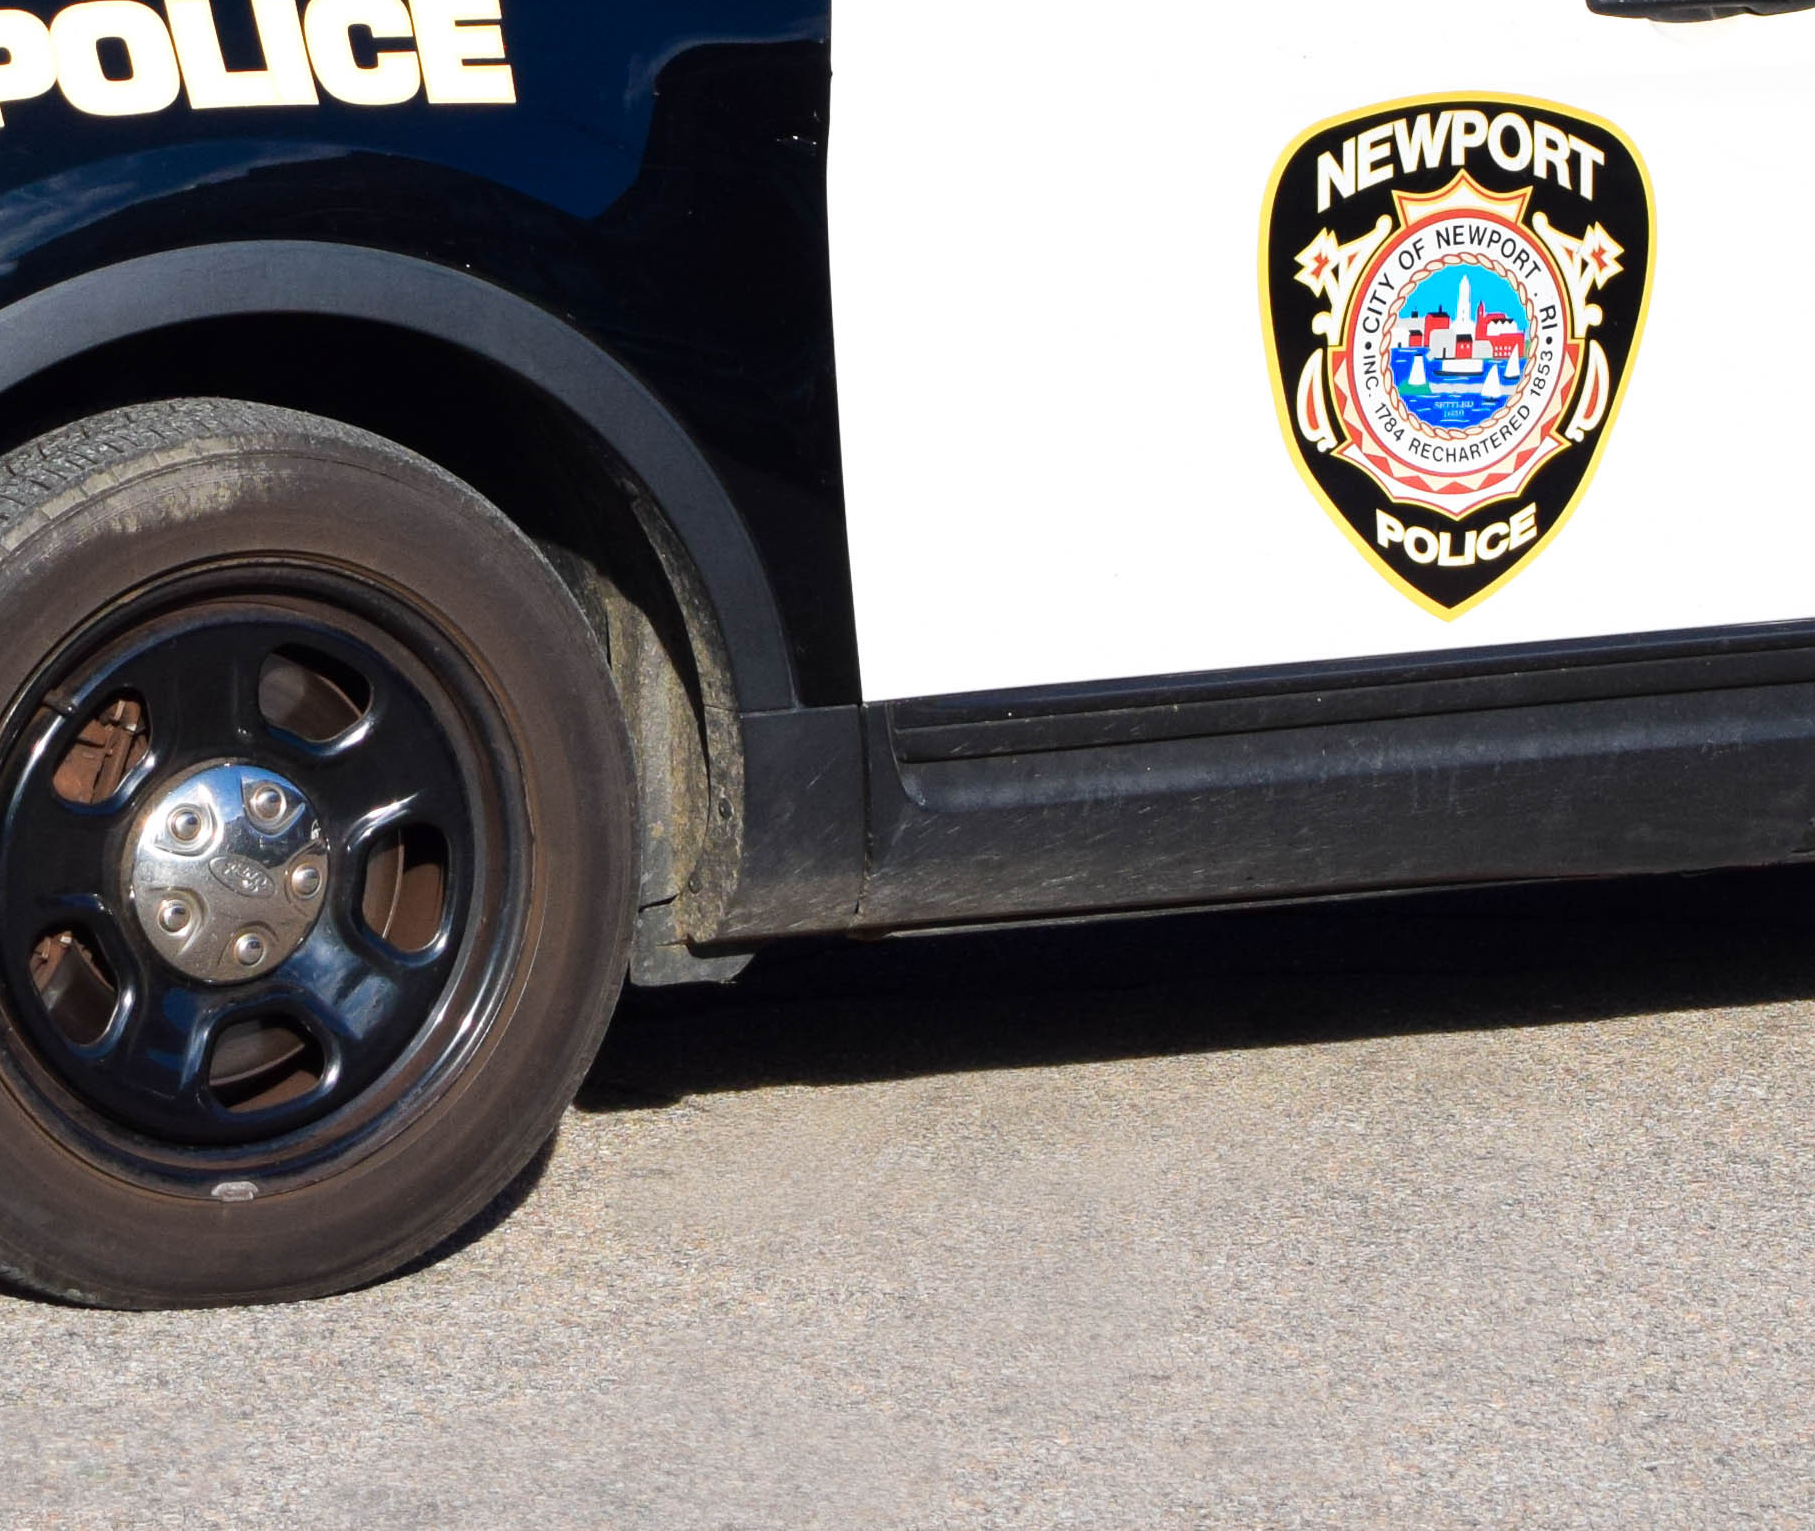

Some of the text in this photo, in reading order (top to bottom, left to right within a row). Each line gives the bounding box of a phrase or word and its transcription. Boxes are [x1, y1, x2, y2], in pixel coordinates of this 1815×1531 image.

[1316, 109, 1605, 213] NEWPORT
[1362, 224, 1558, 334] CITY OF NEWPORT RI
[1374, 402, 1405, 442] 1784
[1408, 404, 1531, 463] RECHARTERED
[1530, 350, 1554, 397] 1853
[1375, 503, 1538, 567] POLICE
